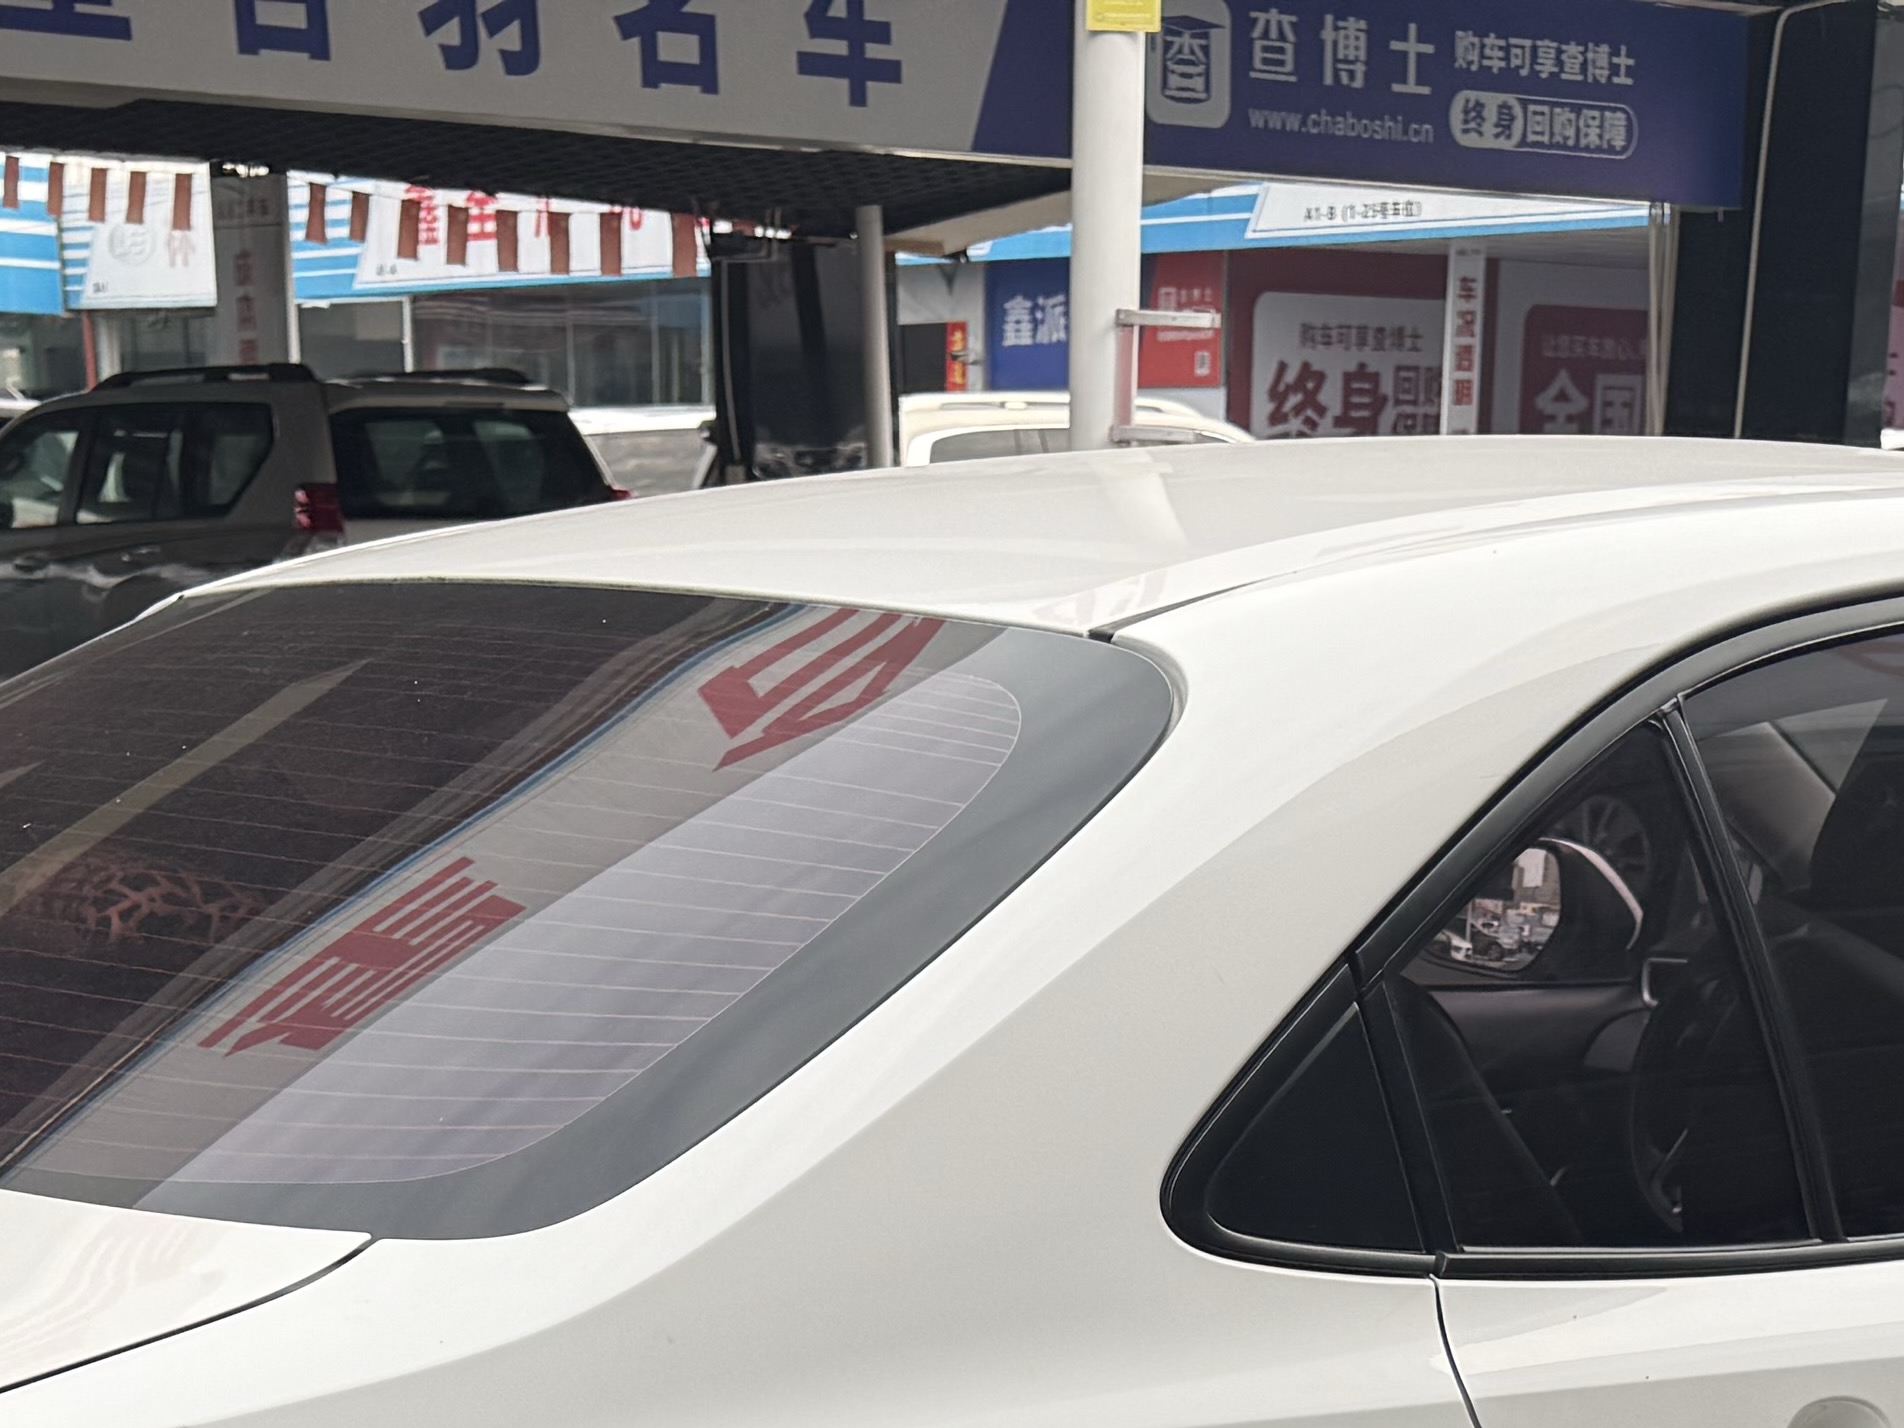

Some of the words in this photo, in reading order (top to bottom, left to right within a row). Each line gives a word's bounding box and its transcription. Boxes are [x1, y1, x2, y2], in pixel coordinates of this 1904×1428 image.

[1249, 8, 1436, 95] 查博士
[1453, 30, 1636, 86] 购车可享查博士
[1248, 108, 1436, 144] www.chaboshi.cn
[1460, 97, 1517, 142] 终身
[1526, 103, 1628, 152] 回购保障
